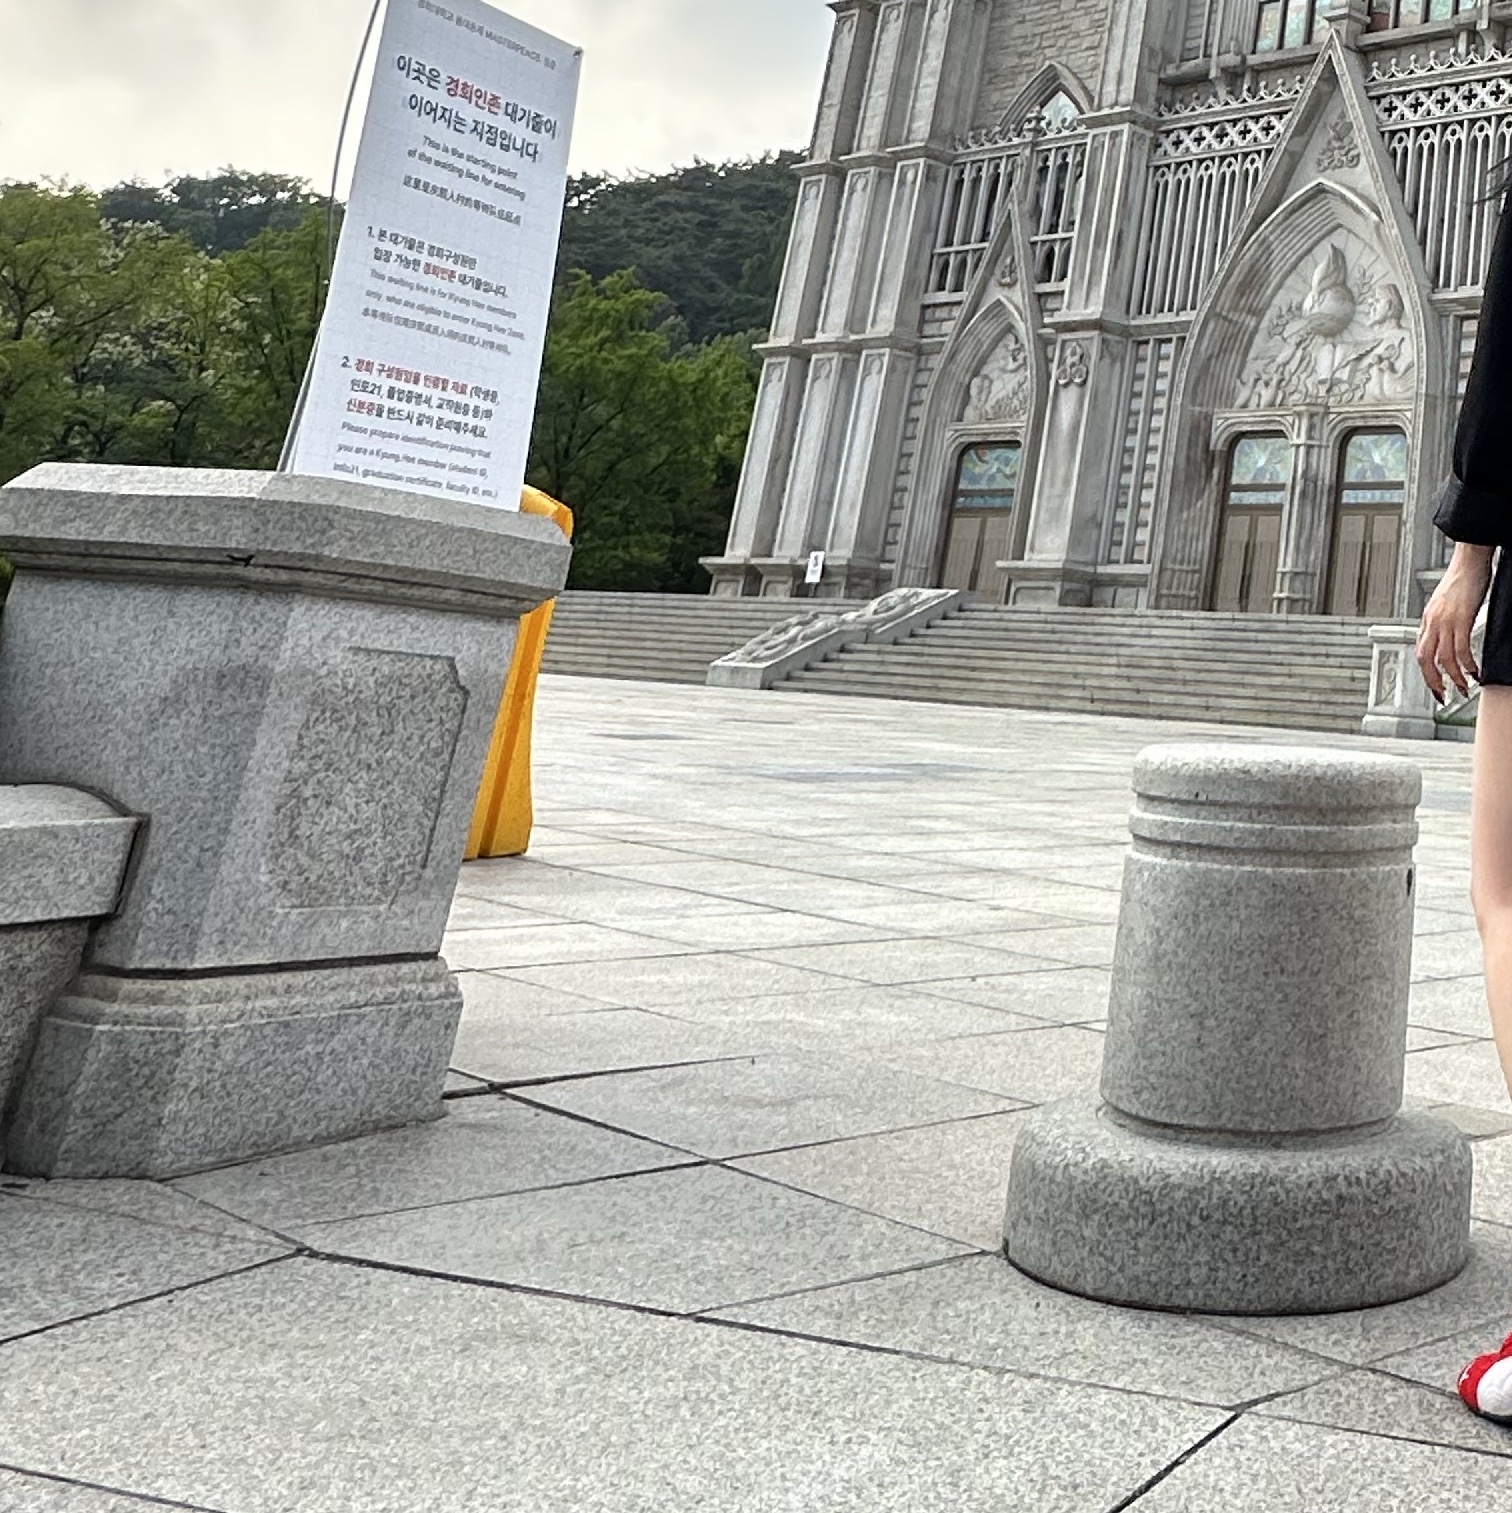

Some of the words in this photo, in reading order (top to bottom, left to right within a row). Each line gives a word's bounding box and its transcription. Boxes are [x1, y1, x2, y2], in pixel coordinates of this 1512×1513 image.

[397, 55, 441, 90] 이곳은
[446, 75, 502, 116] 경희인존
[504, 101, 557, 139] 대기줄이
[409, 94, 466, 134] 이어지는
[469, 119, 538, 162] 지점입니다
[408, 149, 417, 157] of
[418, 152, 432, 164] the
[434, 159, 464, 178] waiting
[465, 169, 479, 182] line
[481, 174, 492, 186] for
[494, 182, 526, 201] entering
[424, 135, 440, 150] This
[442, 143, 449, 154] is
[451, 148, 464, 158] the
[466, 154, 496, 173] starting
[498, 166, 518, 179] point
[367, 226, 375, 238] 1.
[378, 228, 387, 242] 본
[389, 233, 425, 254] 대기줄은
[374, 247, 392, 263] 입장
[394, 253, 421, 272] 가능한
[458, 274, 508, 298] 대기줄입니다.
[387, 276, 414, 291] waiting
[341, 356, 352, 368] 2.
[354, 358, 374, 375] 경희
[347, 398, 385, 418] 신분증을
[387, 406, 414, 424] 반드시
[341, 421, 368, 434] Please
[369, 427, 400, 441] prepare
[401, 431, 449, 450] identification
